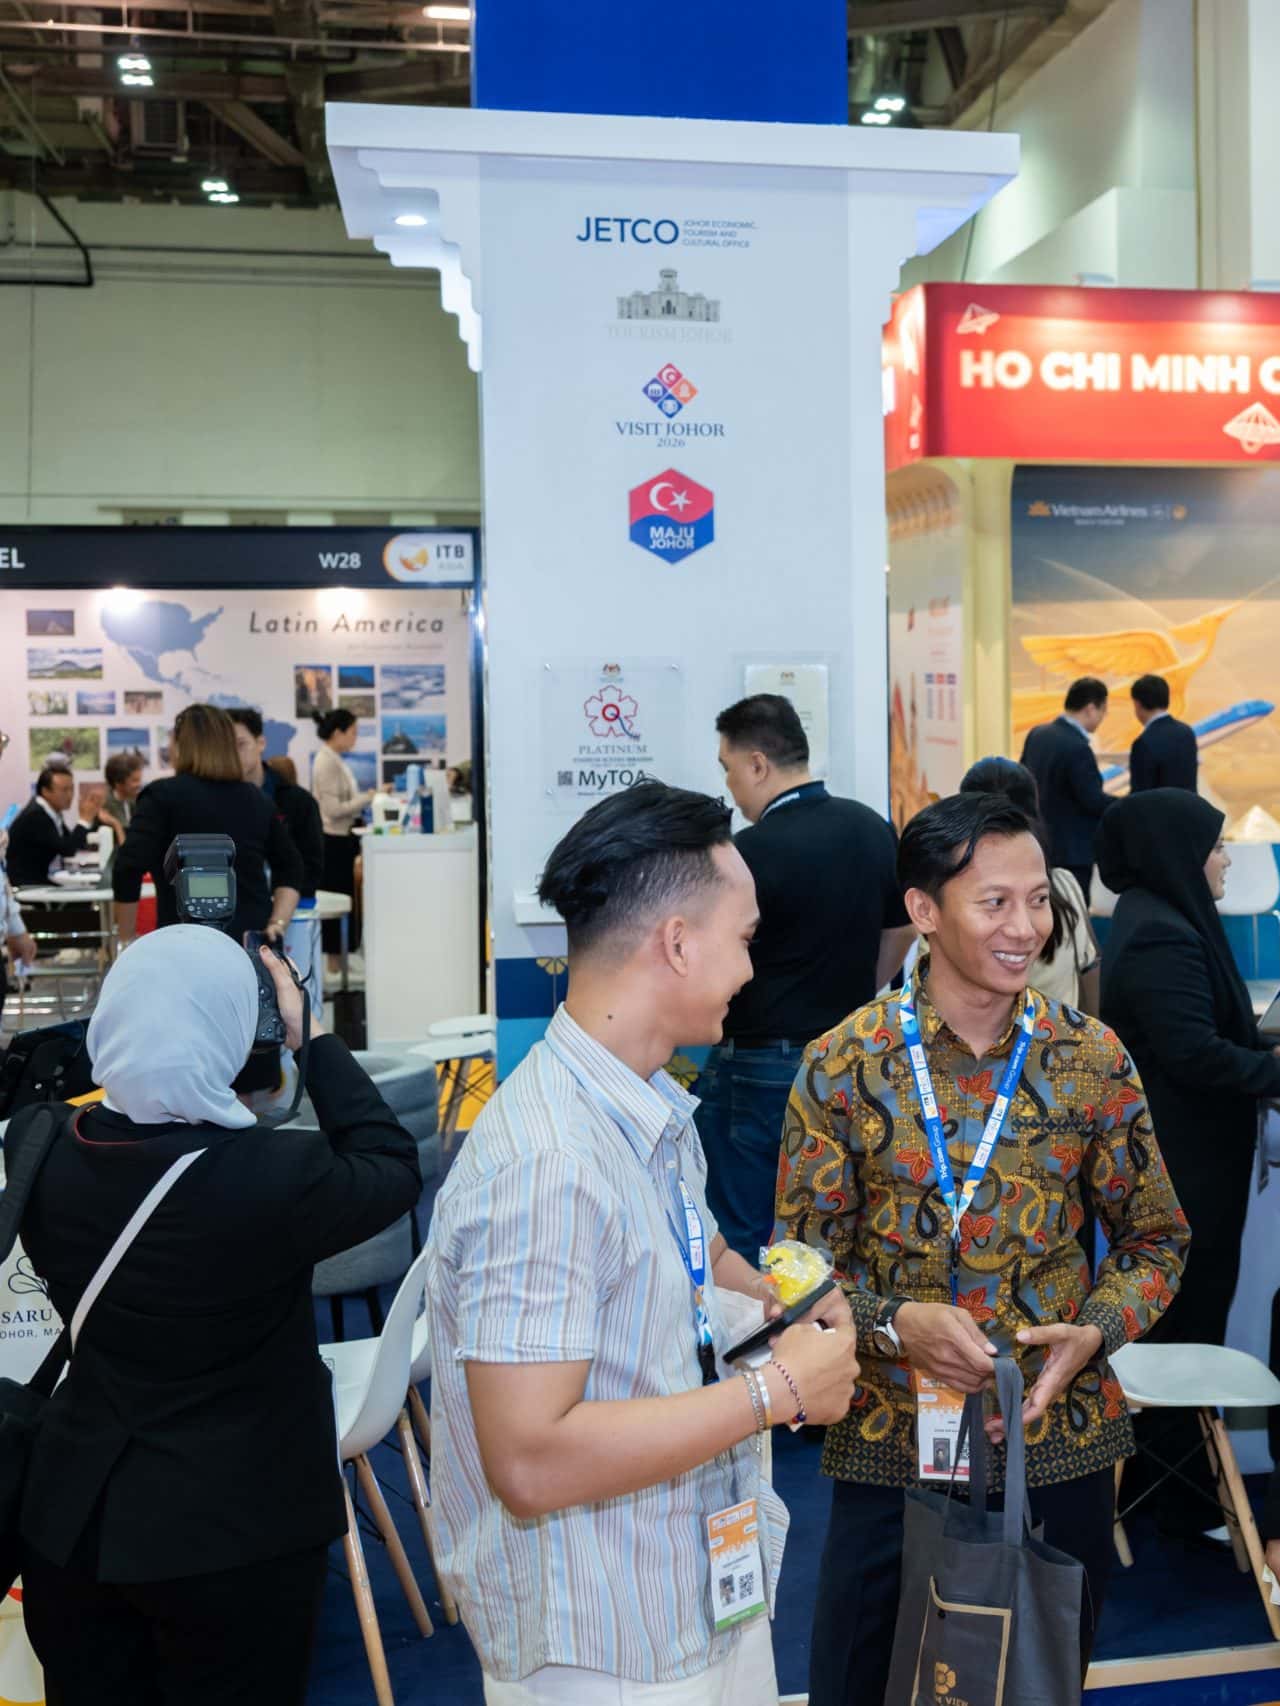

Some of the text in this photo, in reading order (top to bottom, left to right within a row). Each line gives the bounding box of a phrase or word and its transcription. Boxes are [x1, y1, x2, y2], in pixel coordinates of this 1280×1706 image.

[576, 217, 679, 244] JETCO
[684, 219, 711, 228] JOHOR
[684, 229, 717, 238] TOURISM
[683, 239, 750, 248] CULTURAL OFFICE
[960, 350, 1032, 389] HO
[1040, 352, 1121, 391] CHI
[1131, 354, 1251, 394] MINH
[615, 422, 725, 437] VISIT JOHOR
[657, 438, 686, 448] 2026
[649, 526, 695, 539] MAJU
[436, 544, 464, 558] ITB
[649, 539, 695, 549] JOHOR
[319, 552, 362, 569] W28
[249, 611, 444, 633] Latin America
[578, 744, 648, 755] PLATINUM
[936, 1146, 949, 1180] Trip.com
[1, 1309, 52, 1324] SARU
